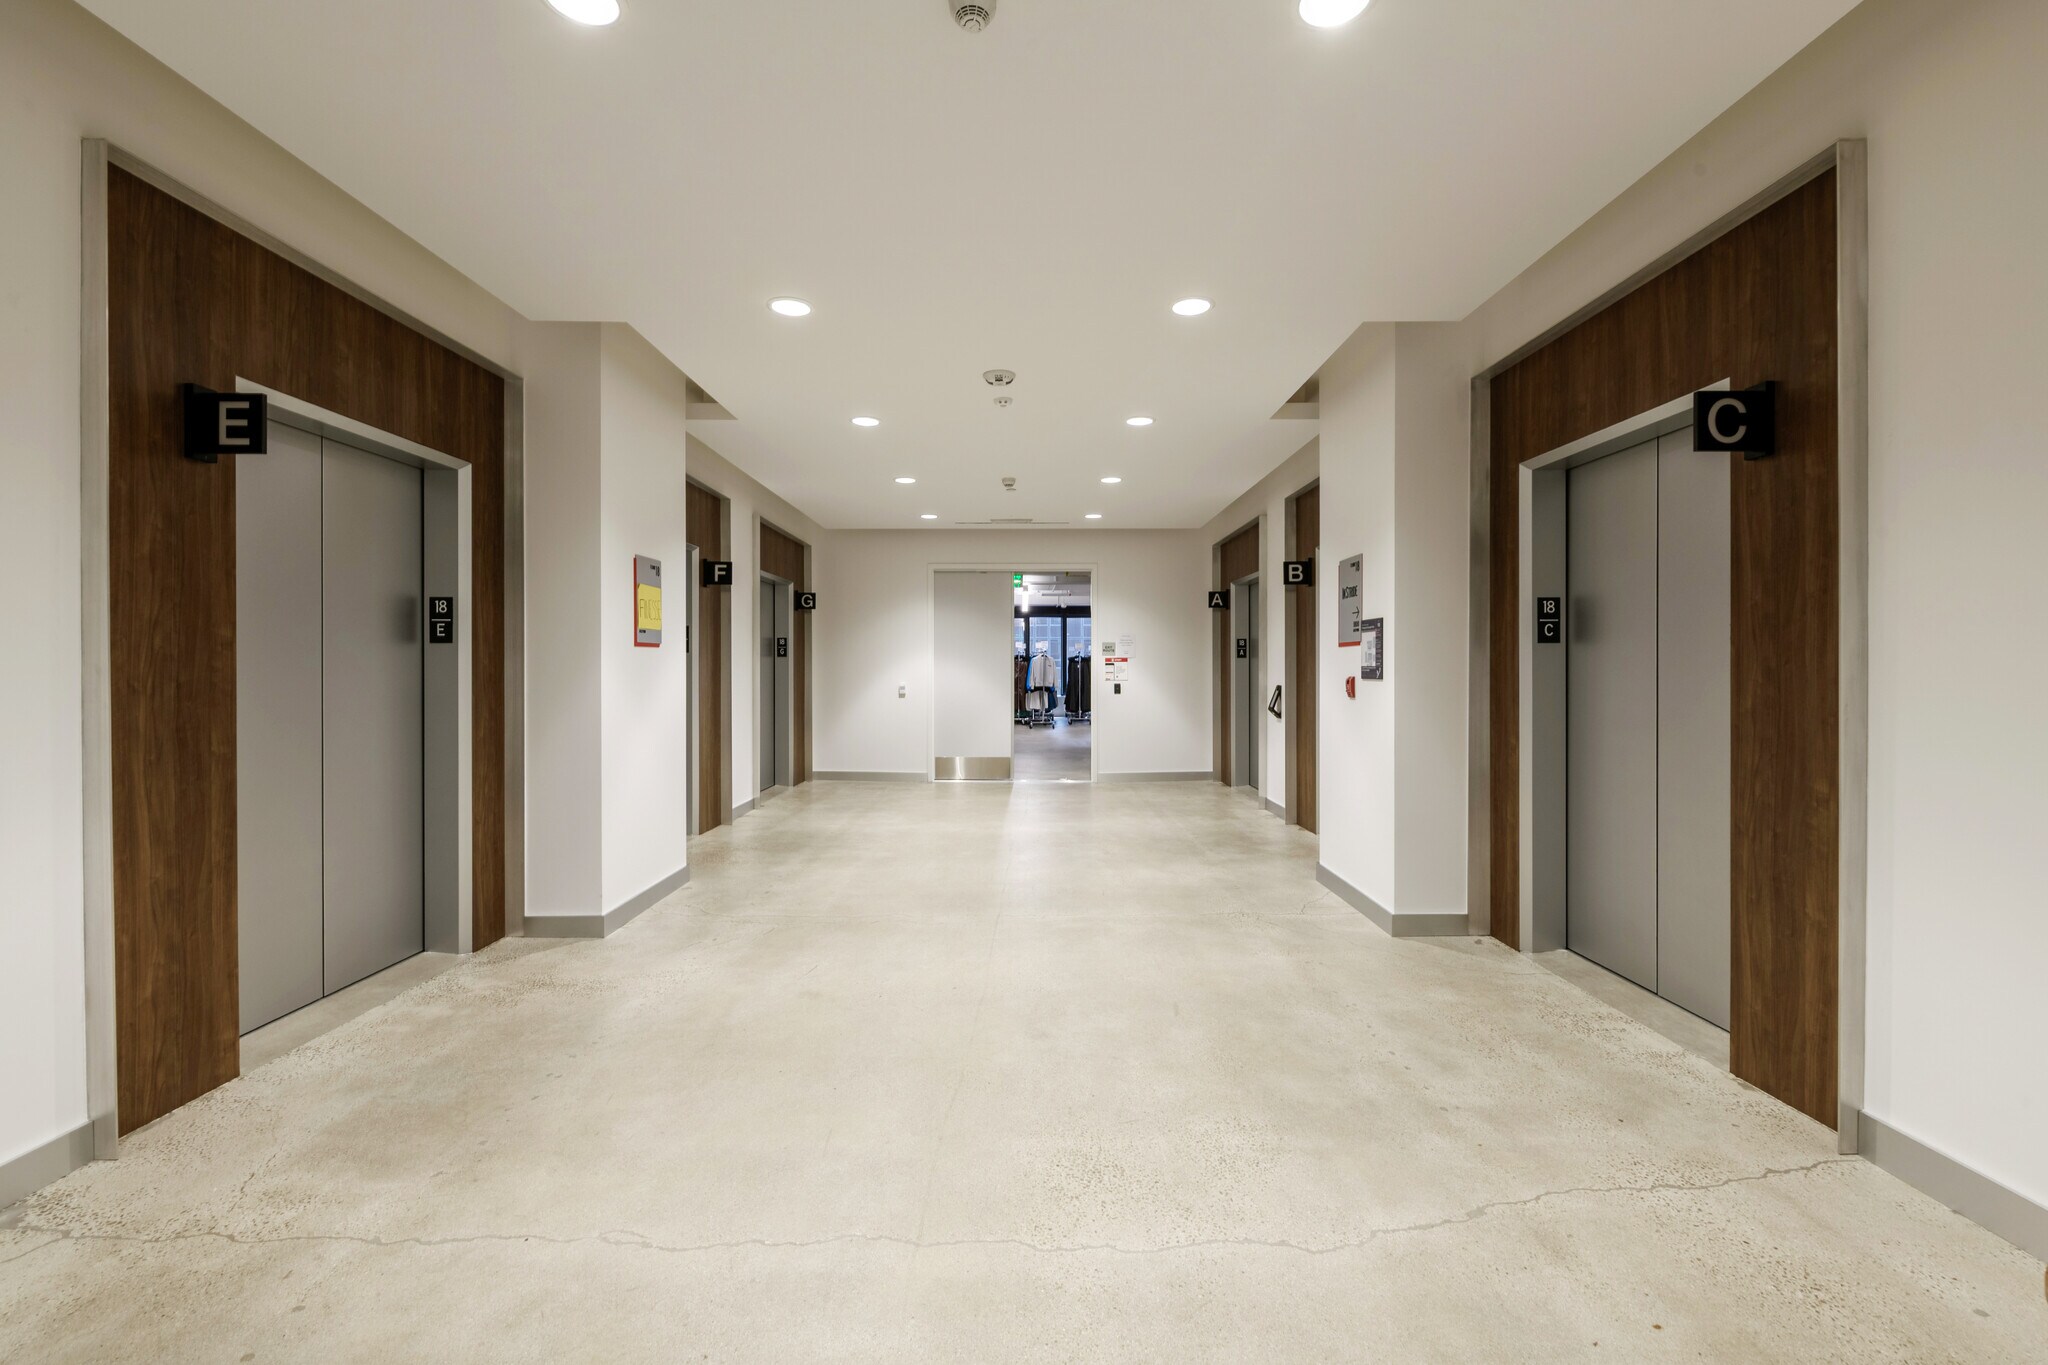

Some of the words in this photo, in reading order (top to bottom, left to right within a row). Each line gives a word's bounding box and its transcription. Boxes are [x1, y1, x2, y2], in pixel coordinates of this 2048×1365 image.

[219, 400, 250, 446] E
[1707, 397, 1747, 444] C
[714, 564, 727, 582] F
[1288, 564, 1304, 582] B
[434, 600, 448, 613] 18
[801, 594, 814, 608] G
[1211, 593, 1223, 606] A
[1542, 600, 1556, 613] 18
[436, 623, 446, 637] E
[1544, 623, 1554, 637] C
